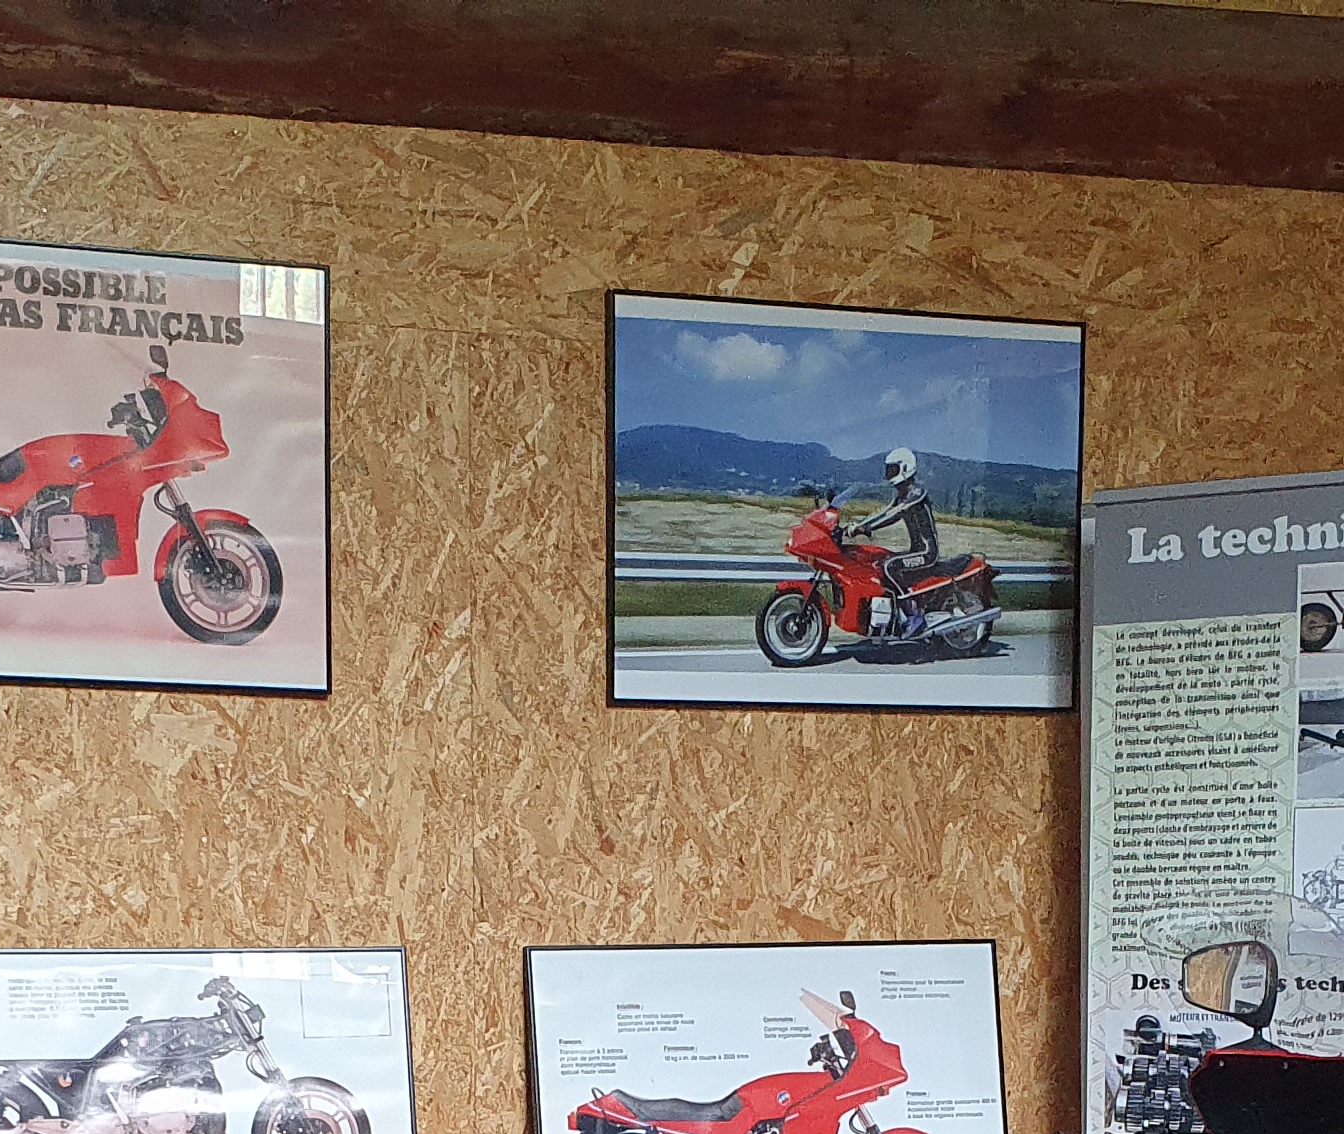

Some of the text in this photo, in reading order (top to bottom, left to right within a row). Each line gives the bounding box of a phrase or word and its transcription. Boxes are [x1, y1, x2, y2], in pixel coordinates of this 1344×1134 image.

[56, 303, 244, 346] FRANÇAIS
[1127, 527, 1184, 564] La
[1132, 974, 1170, 991] Des
